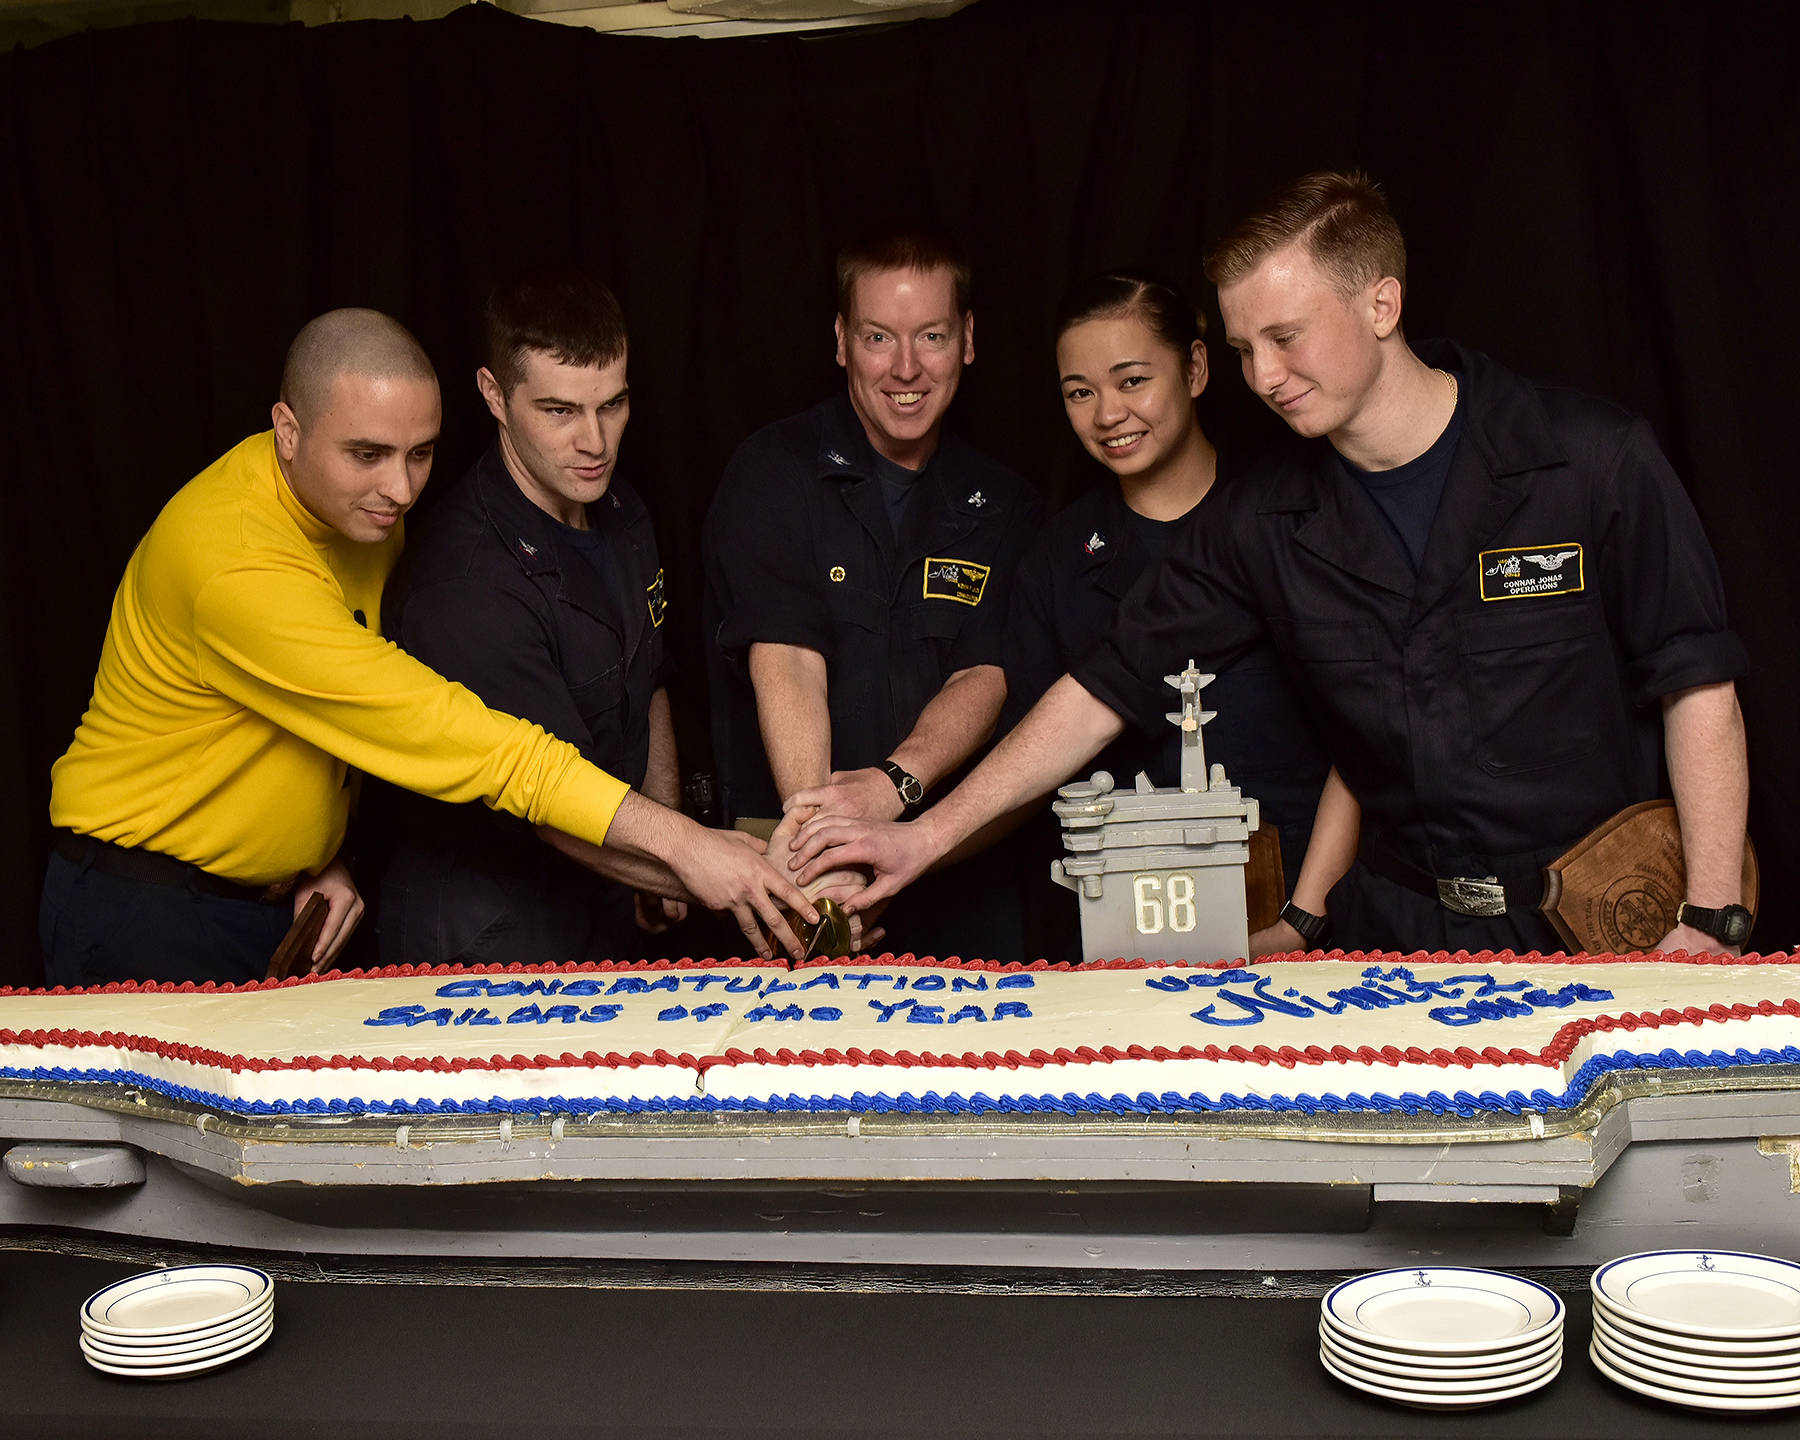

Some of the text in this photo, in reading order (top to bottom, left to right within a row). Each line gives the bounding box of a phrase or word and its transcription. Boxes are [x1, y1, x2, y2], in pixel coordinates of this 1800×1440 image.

[1503, 574, 1563, 589] CONNAR JONAS
[1510, 581, 1558, 595] OPERATIONS
[1132, 871, 1197, 935] 68
[436, 974, 1035, 998] CONGRATULATIONS
[363, 1003, 625, 1028] SAILORS
[658, 1002, 731, 1023] OF
[868, 999, 1033, 1025] YEAR
